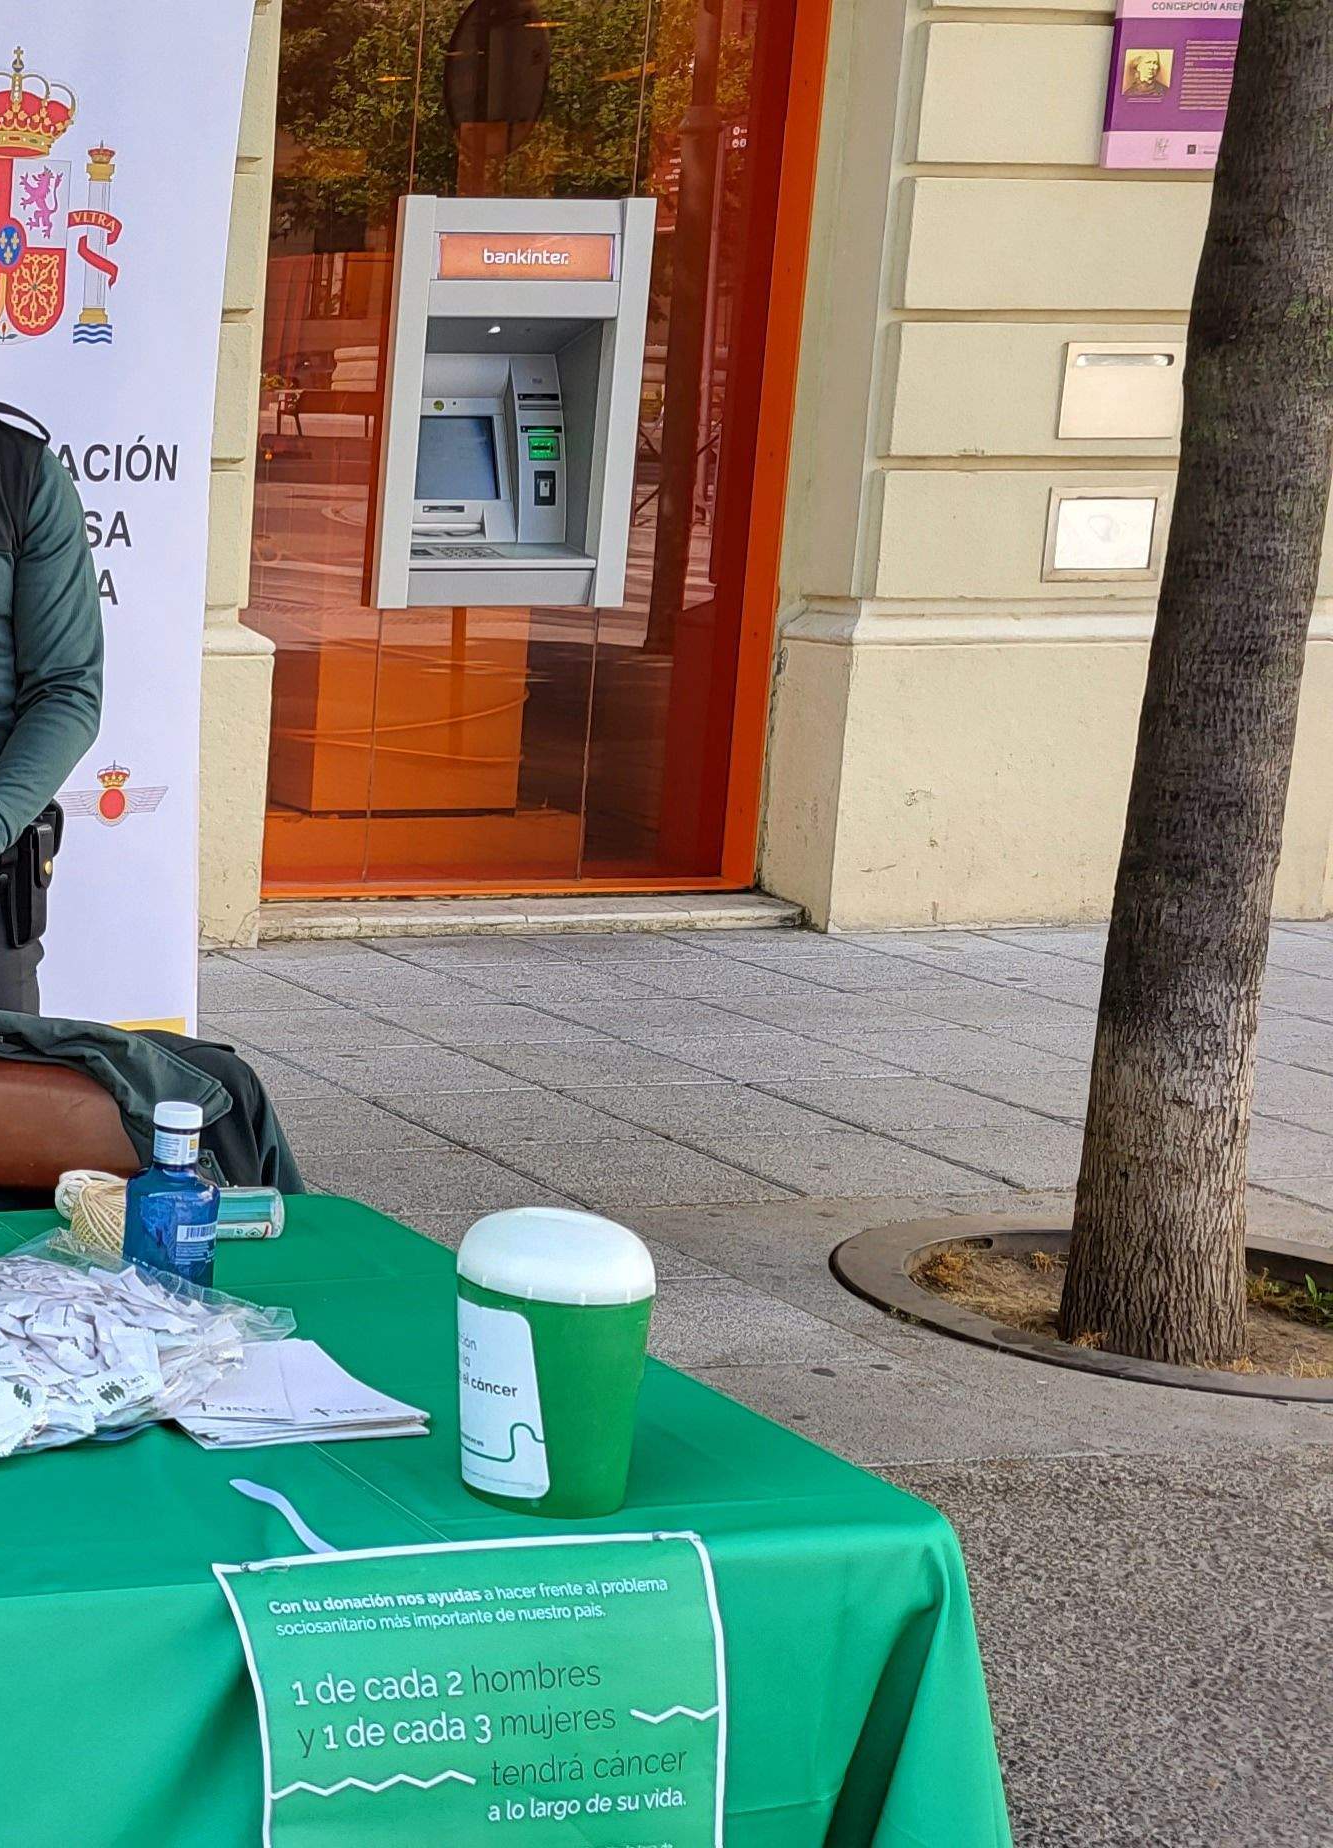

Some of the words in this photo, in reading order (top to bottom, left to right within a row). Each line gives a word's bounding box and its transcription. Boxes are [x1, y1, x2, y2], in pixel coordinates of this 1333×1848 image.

[1151, 0, 1217, 11] CONCEPCIÓN
[483, 248, 569, 265] bankinter.
[470, 1376, 518, 1398] cáncer
[269, 1600, 301, 1615] Con
[302, 1598, 322, 1612] tu
[324, 1593, 396, 1611] donación
[397, 1593, 425, 1607] nos
[427, 1588, 482, 1609] ayudas
[483, 1590, 495, 1601] a
[495, 1586, 537, 1600] hacer
[539, 1582, 583, 1598] frente
[585, 1580, 599, 1595] al
[601, 1577, 669, 1598] problema
[275, 1616, 377, 1637] sociosanitario
[379, 1613, 412, 1630] más
[413, 1610, 493, 1631] importante
[495, 1607, 515, 1622] de
[517, 1604, 572, 1621] nuestro
[291, 1679, 310, 1706] 1
[315, 1672, 357, 1705] de
[364, 1668, 439, 1701] cada
[445, 1670, 465, 1697] 2
[470, 1661, 602, 1694] hombres
[297, 1727, 315, 1759] y
[322, 1724, 339, 1750] 1
[345, 1716, 386, 1749] de
[393, 1711, 467, 1745] cada
[473, 1713, 493, 1745] 3
[499, 1705, 617, 1740] mujeres
[491, 1752, 585, 1787] tendrá
[593, 1748, 688, 1780] cáncer
[487, 1805, 501, 1822] a
[506, 1799, 525, 1820] lo
[529, 1797, 581, 1821] largo
[585, 1793, 613, 1814] de
[616, 1793, 640, 1812] su
[643, 1786, 687, 1811] vida.
